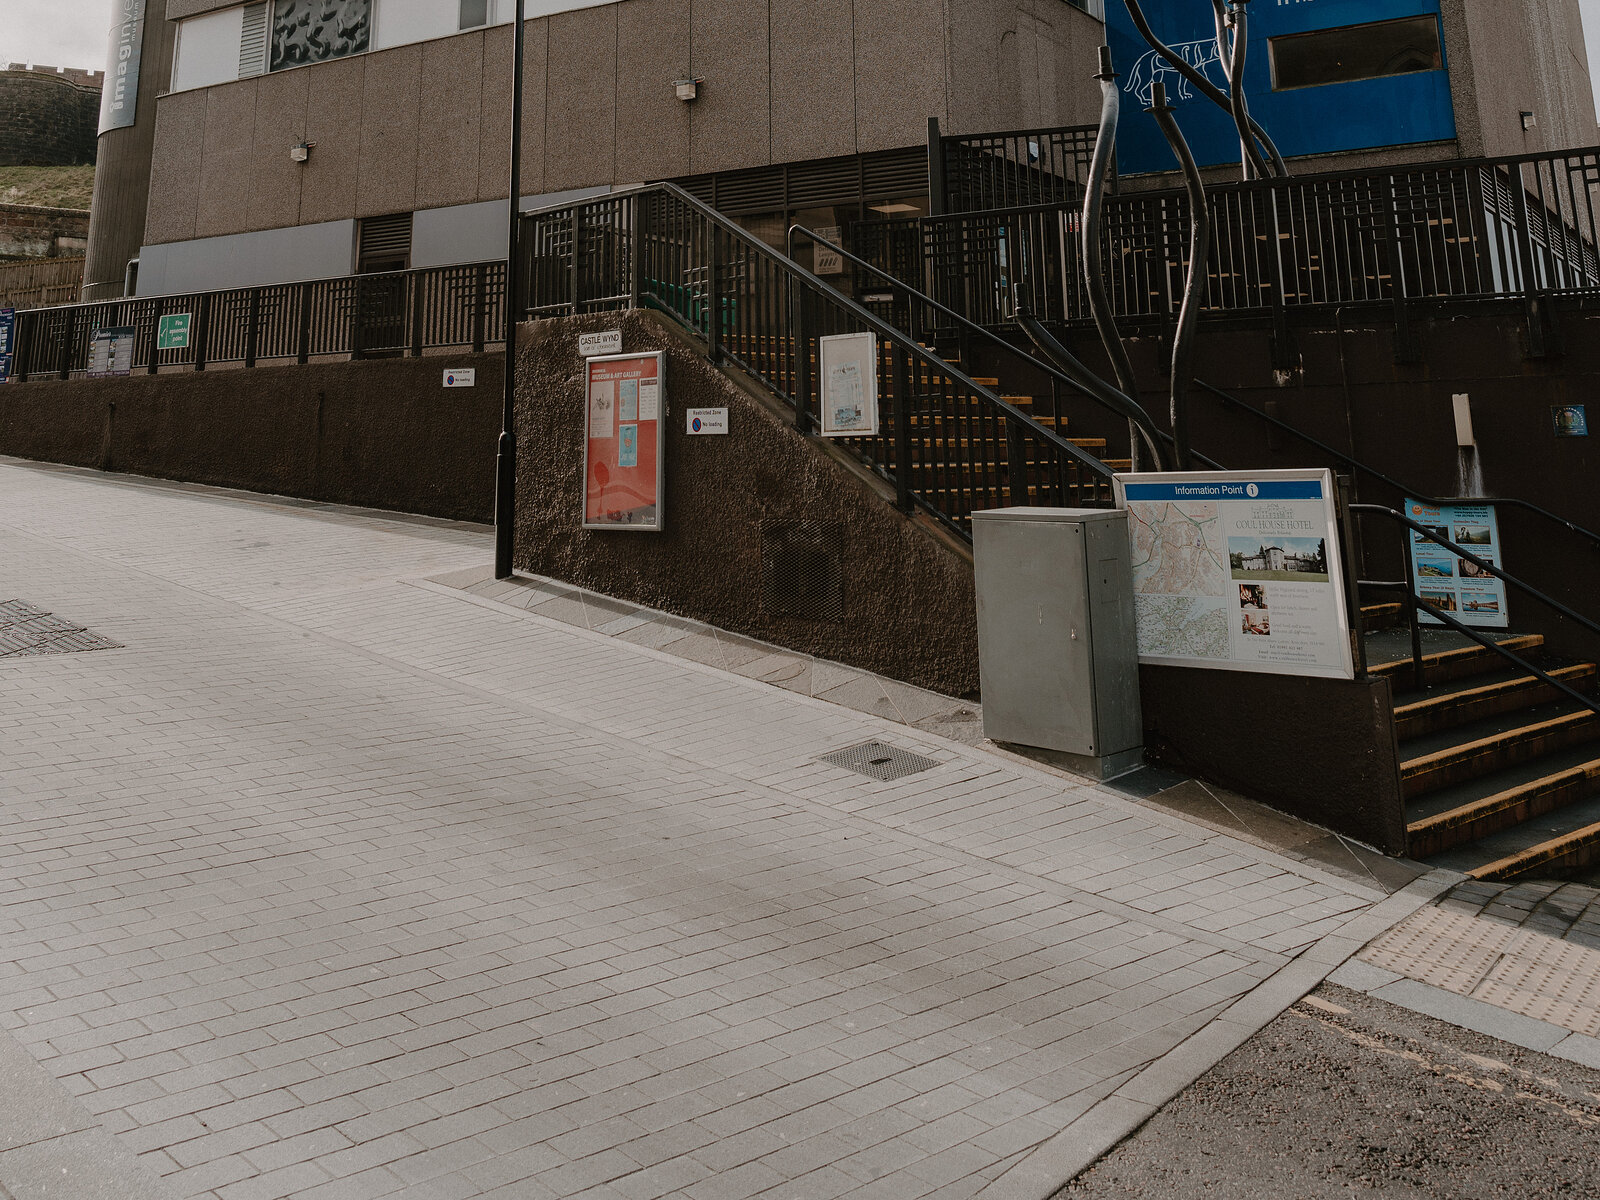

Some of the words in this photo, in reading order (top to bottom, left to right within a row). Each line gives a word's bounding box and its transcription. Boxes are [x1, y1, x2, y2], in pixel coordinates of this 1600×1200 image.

[131, 3, 140, 42] museum
[581, 336, 600, 345] CASTLE
[602, 334, 619, 342] WYND
[1175, 484, 1220, 495] Information
[1222, 484, 1243, 495] Point
[1235, 520, 1257, 530] COUL
[1259, 520, 1286, 530] HOUSE
[1287, 521, 1314, 530] HOTEL
